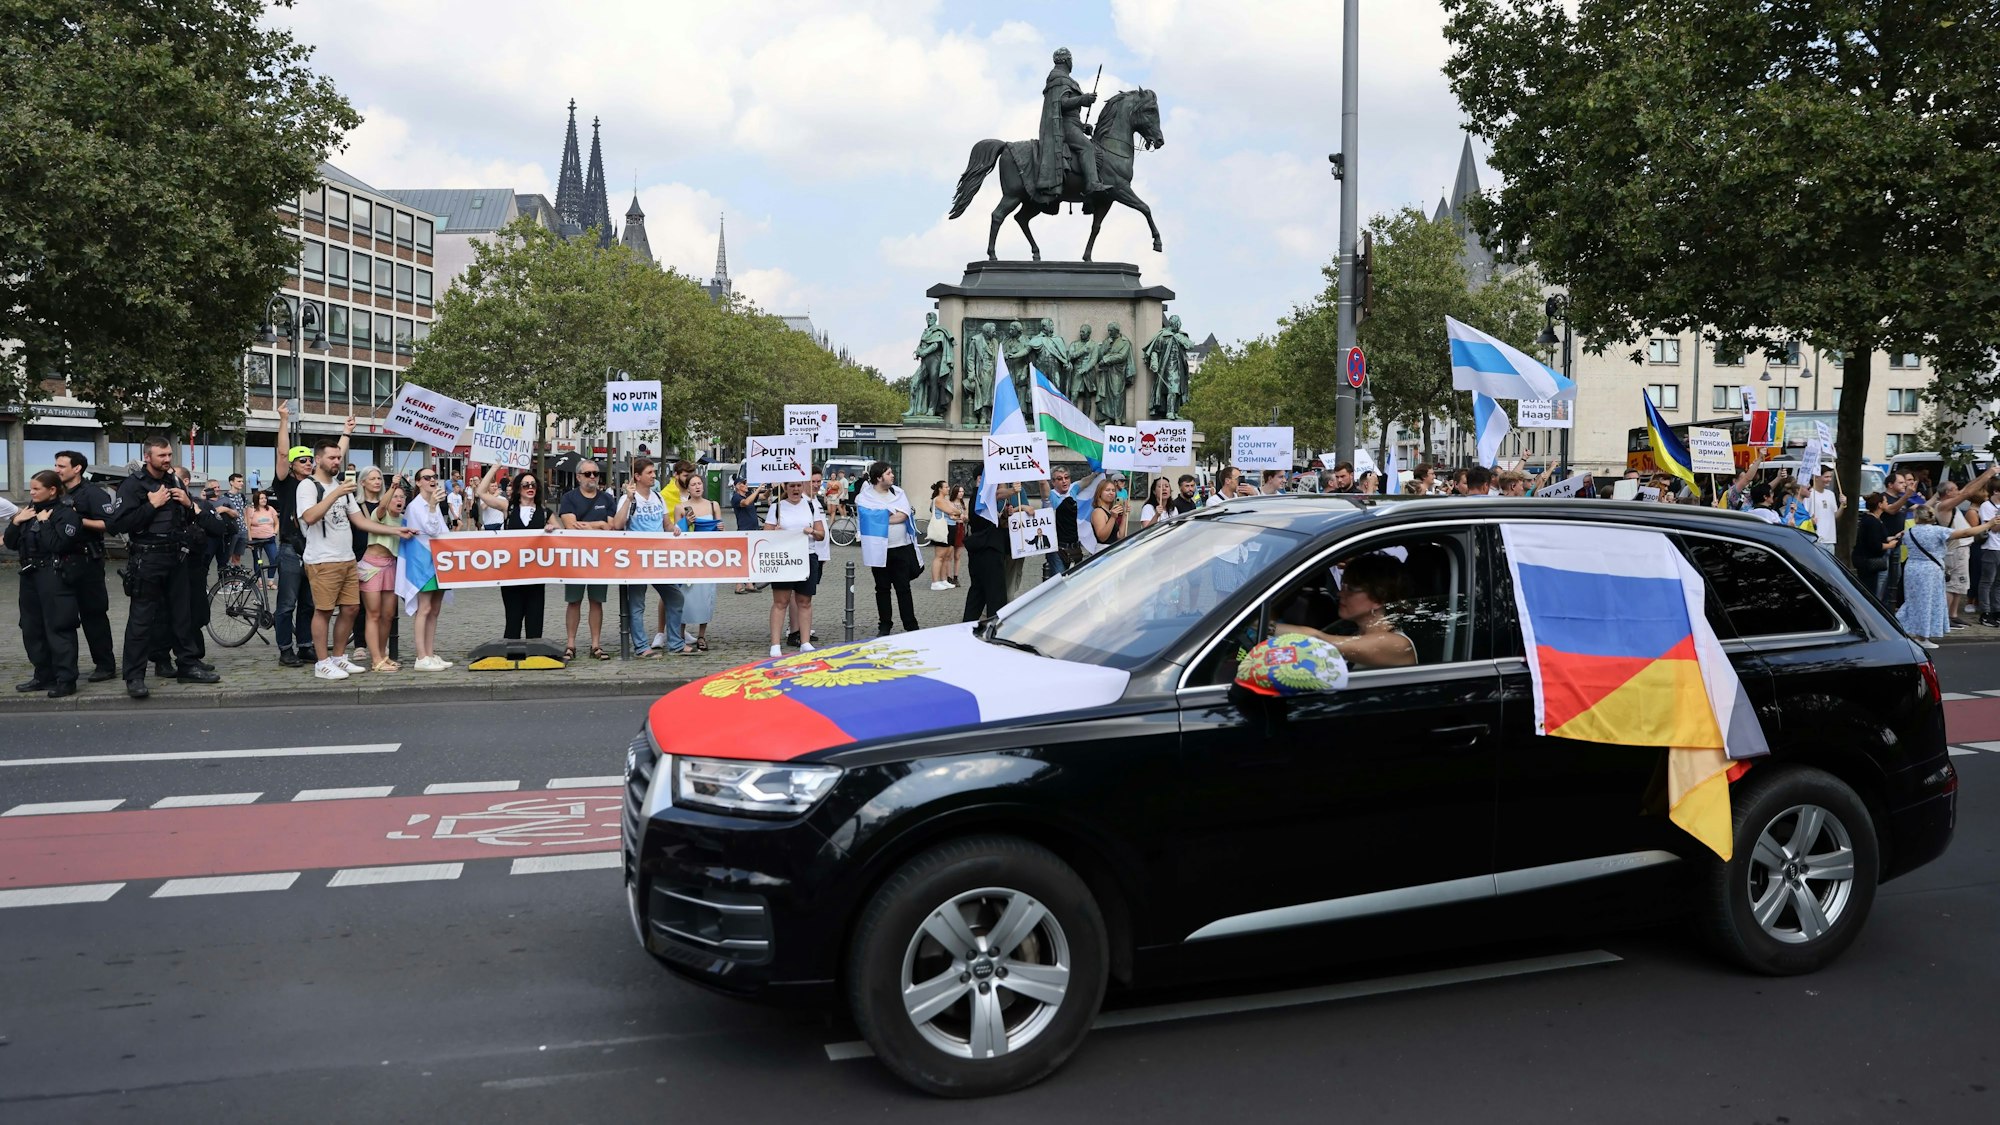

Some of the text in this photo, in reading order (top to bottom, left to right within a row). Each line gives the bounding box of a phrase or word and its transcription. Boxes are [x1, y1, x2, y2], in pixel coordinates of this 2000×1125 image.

[612, 391, 657, 401] NO PUTIN
[405, 396, 436, 413] KEINE
[612, 402, 657, 412] NO WAR
[401, 405, 460, 431] Verhandlungen
[476, 407, 506, 424] PEACE
[513, 413, 526, 427] IN
[1522, 410, 1551, 421] Haag
[395, 414, 413, 426] mit
[414, 420, 455, 440] Mördern
[483, 421, 522, 438] UKRAINE
[1159, 427, 1187, 437] Angst
[473, 432, 530, 453] FREEDOM IN
[1109, 435, 1125, 443] NO
[1690, 439, 1731, 447] ПУТИНСКОЙ
[761, 447, 796, 457] PUTIN
[998, 445, 1033, 455] PUTIN
[1108, 444, 1126, 454] NO
[1157, 443, 1186, 453] tötet
[1698, 449, 1726, 458] армии,
[1540, 484, 1571, 498] WAR
[436, 549, 511, 571] STOP
[636, 549, 742, 568] TERROR
[759, 551, 789, 559] FREIES
[759, 558, 803, 566] RUSSLAND
